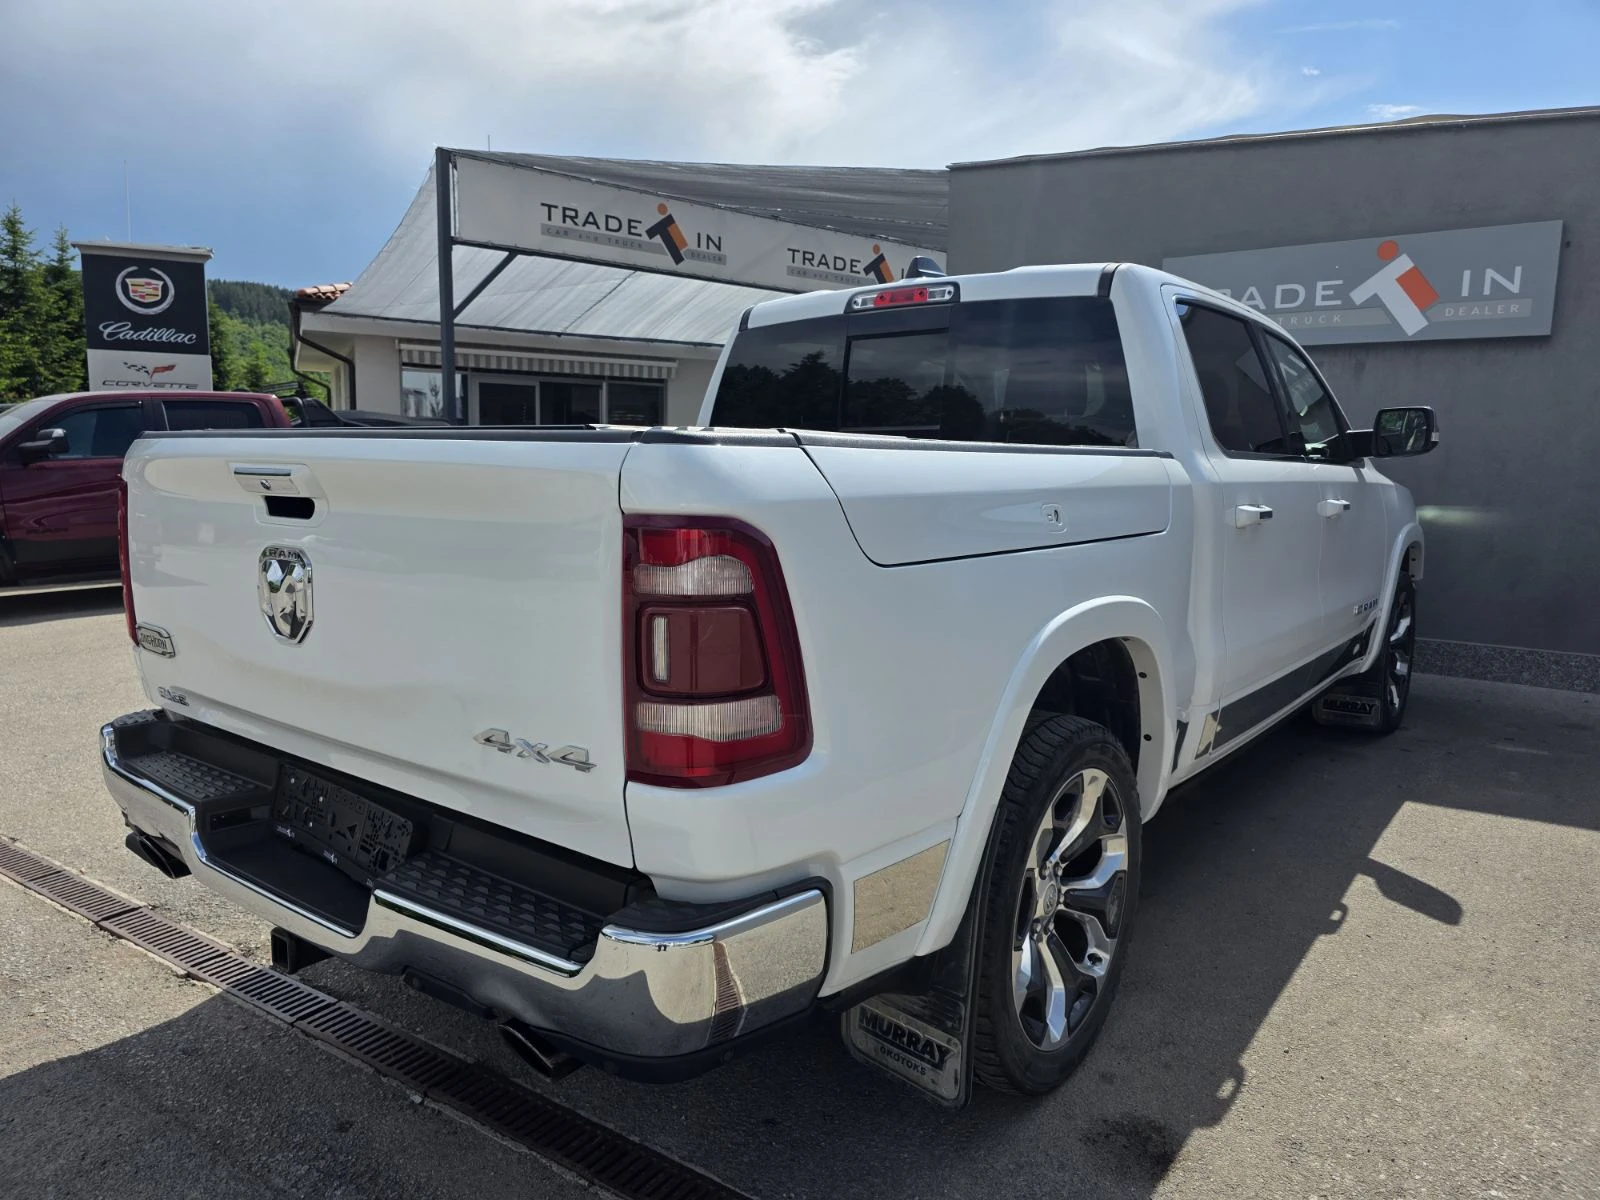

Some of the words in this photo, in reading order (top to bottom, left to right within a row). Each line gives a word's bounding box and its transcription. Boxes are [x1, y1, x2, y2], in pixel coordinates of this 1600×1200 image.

[539, 202, 643, 237] TRADE
[697, 232, 722, 252] IN
[787, 247, 861, 274] TRADE
[1214, 279, 1344, 311] ADE
[1460, 265, 1523, 297] IN
[1444, 304, 1521, 317] DEALER
[98, 321, 197, 345] Cadillac
[102, 380, 199, 390] CORVETTE
[268, 547, 302, 560] RAM
[860, 1003, 955, 1071] MURRAY
[880, 1046, 928, 1076] OKOTOKS
